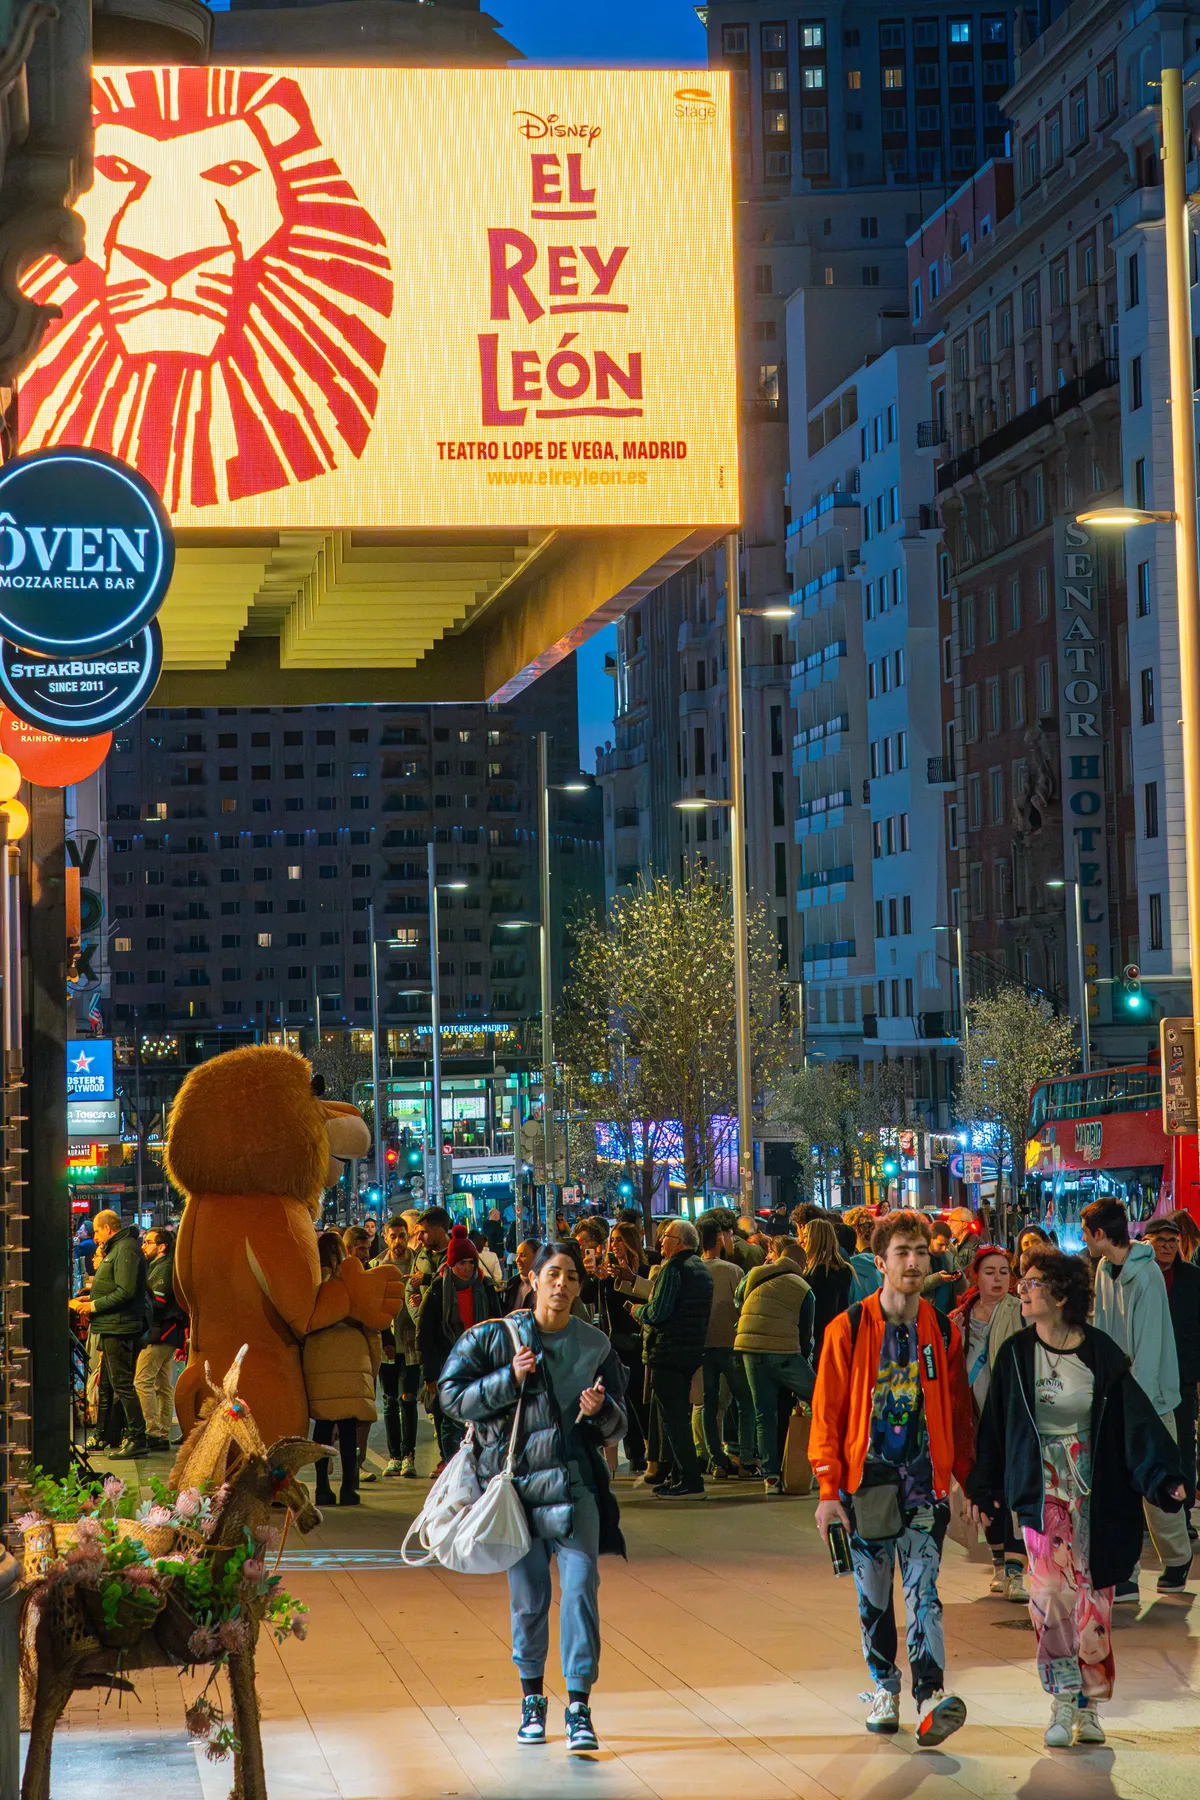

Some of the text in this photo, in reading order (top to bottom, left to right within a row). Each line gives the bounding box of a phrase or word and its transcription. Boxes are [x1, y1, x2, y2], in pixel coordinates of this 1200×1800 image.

[675, 104, 716, 120] Stage
[531, 153, 596, 203] EL
[487, 228, 630, 324] REY
[477, 332, 643, 426] LEÓN
[437, 441, 687, 462] TEATRO LOPE DE VEGA, MADRID
[487, 468, 648, 487] www.elreyleon.es
[0, 512, 150, 573] ÔVEN
[0, 576, 135, 590] MOZZARELLA BAR
[1063, 521, 1100, 737] SENATOR
[48, 681, 104, 693] SINCE 2011
[1068, 755, 1104, 924] HOTEL
[75, 1110, 117, 1119] Toscana
[1075, 1121, 1103, 1152] MADRID
[459, 1174, 472, 1187] 74
